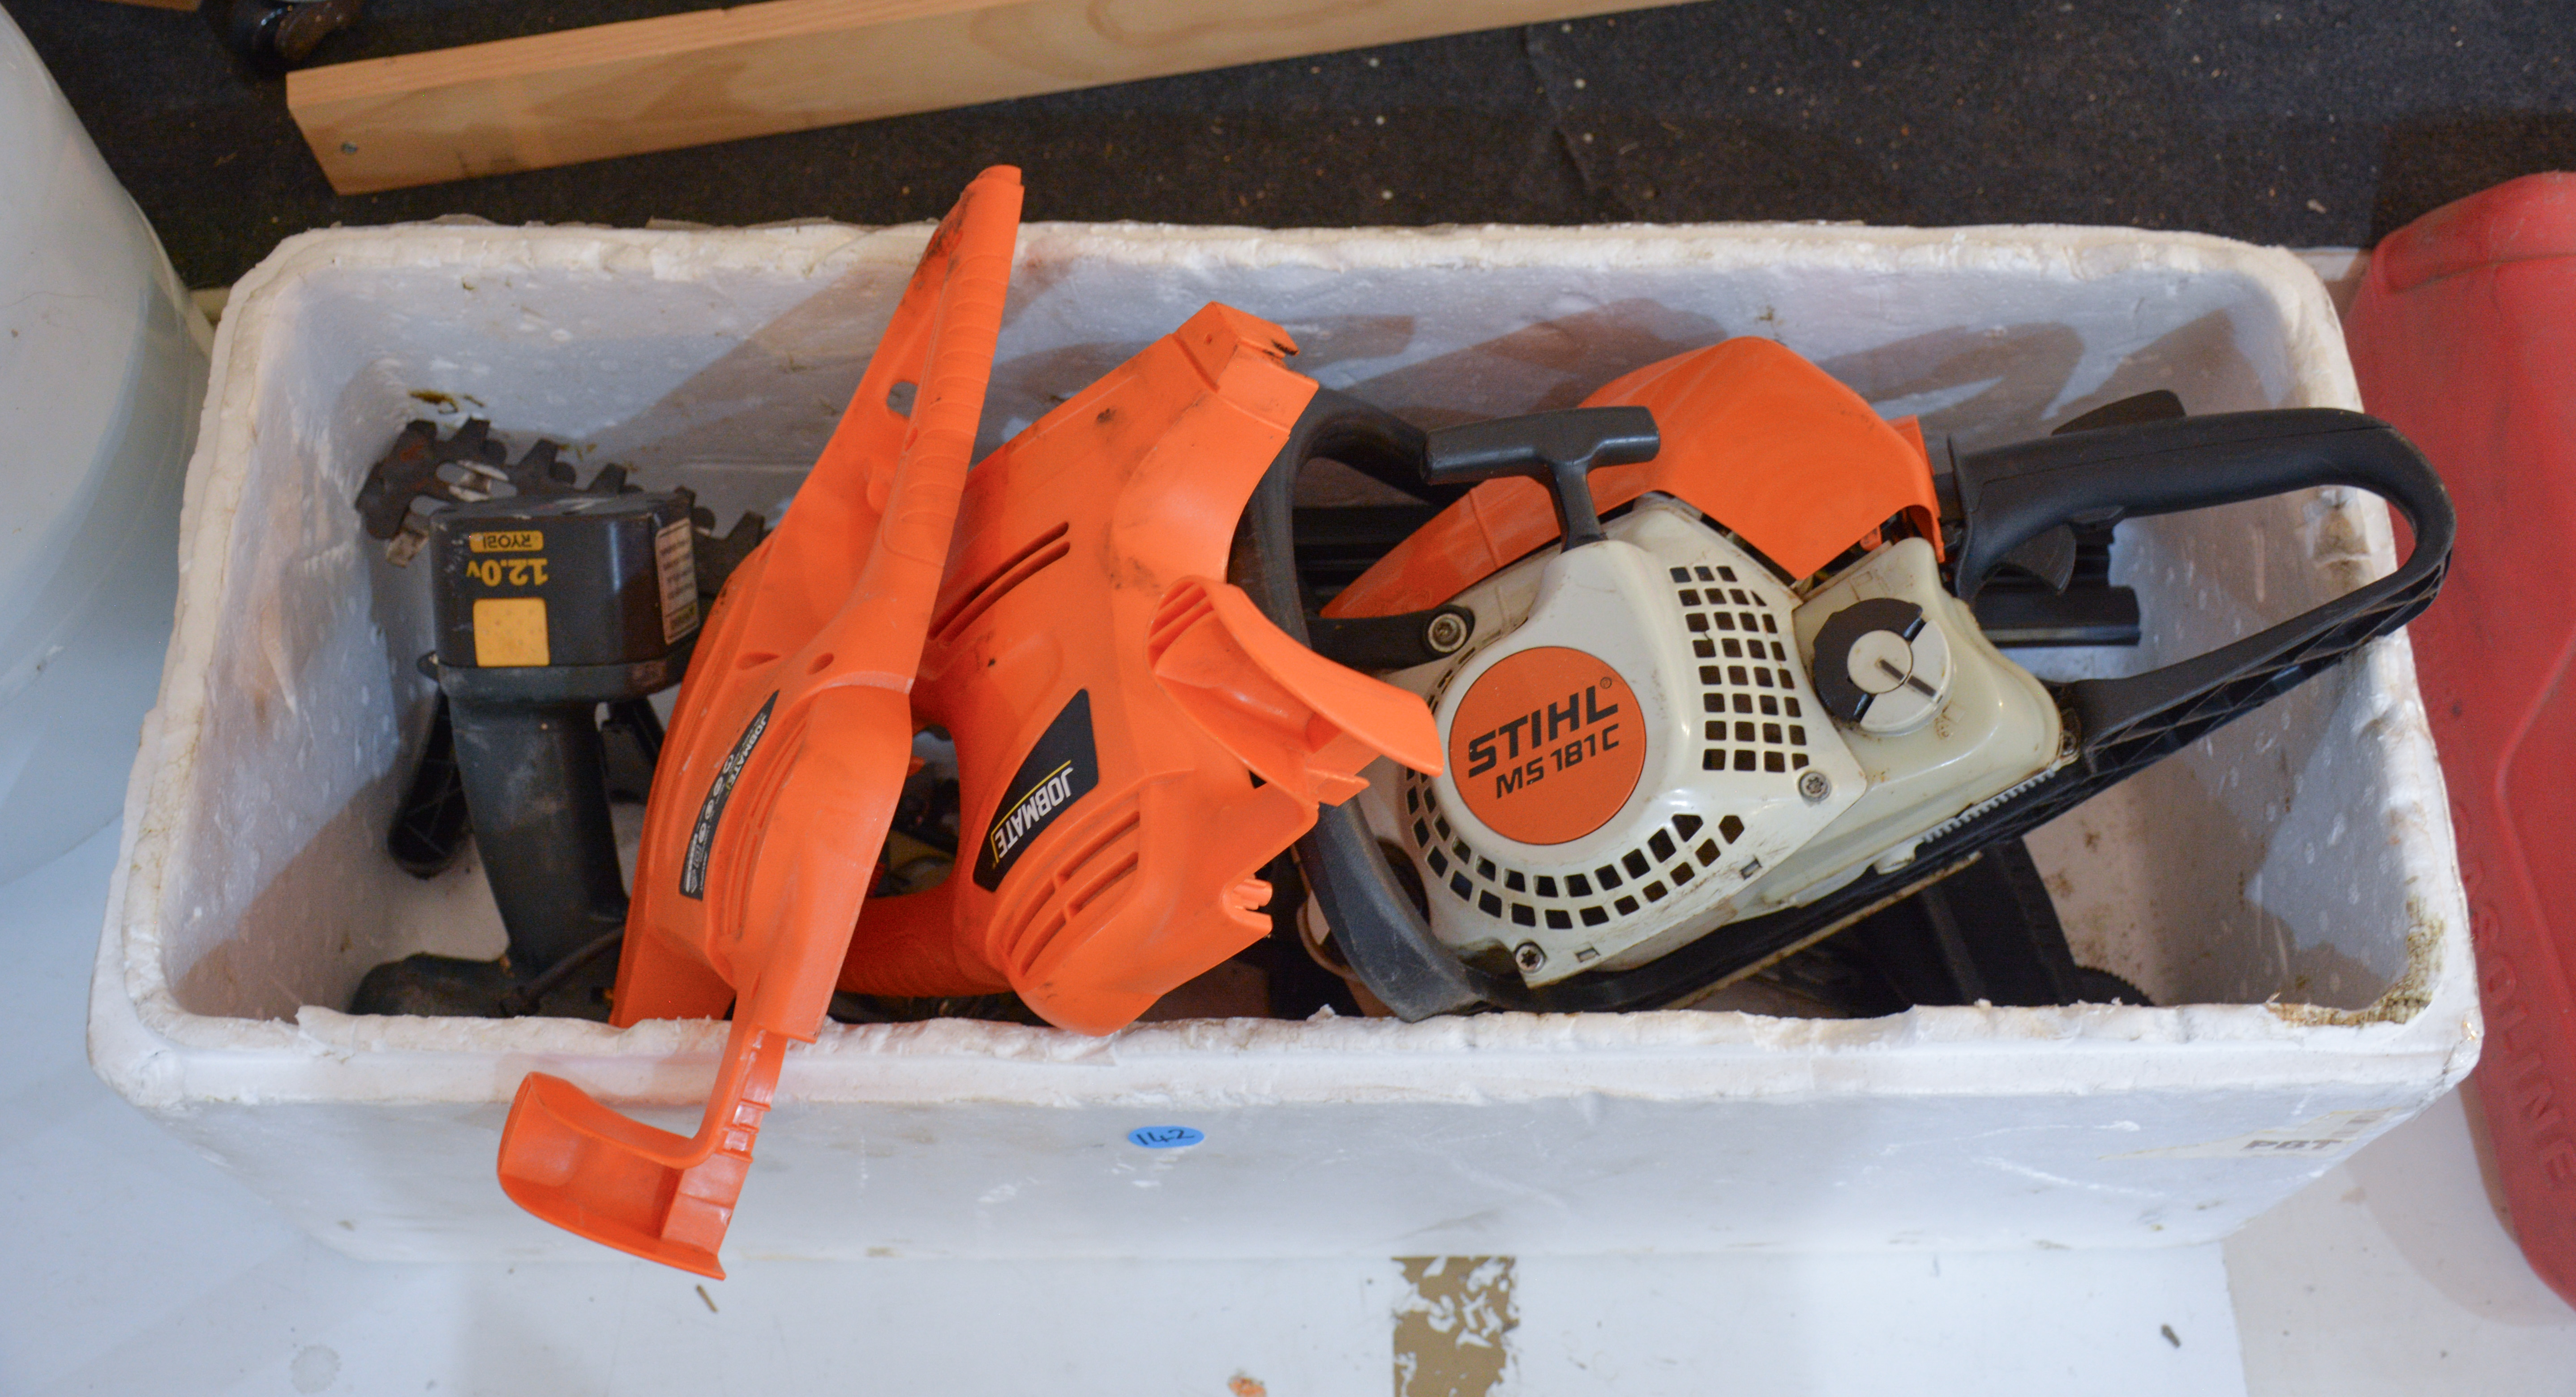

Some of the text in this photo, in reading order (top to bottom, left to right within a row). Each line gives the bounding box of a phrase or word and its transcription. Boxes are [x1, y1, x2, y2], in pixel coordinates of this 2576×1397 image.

[484, 534, 531, 549] RYOBI
[728, 715, 767, 788] JOBMATE
[1469, 685, 1618, 778] STIHL
[1496, 723, 1620, 799] MS 181 C
[994, 767, 1073, 859] JOBMATE
[1136, 1128, 1195, 1145] 142
